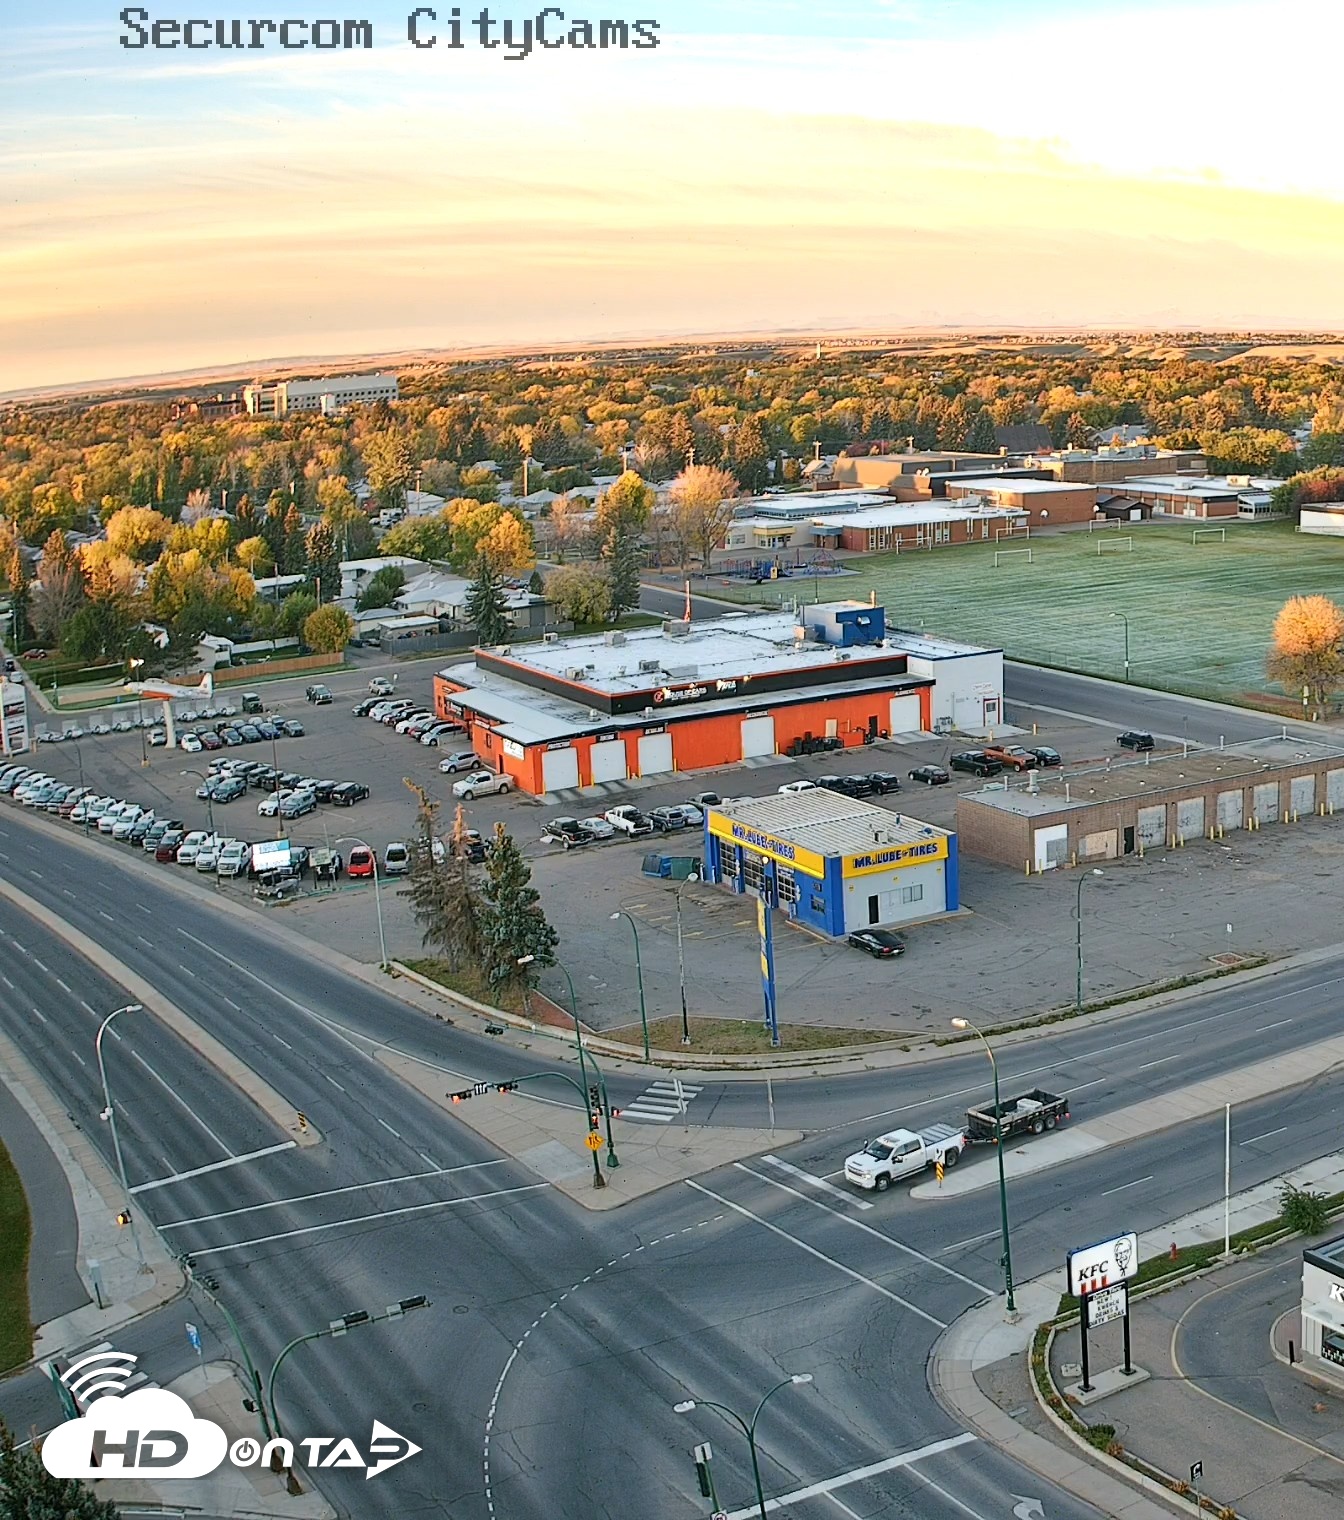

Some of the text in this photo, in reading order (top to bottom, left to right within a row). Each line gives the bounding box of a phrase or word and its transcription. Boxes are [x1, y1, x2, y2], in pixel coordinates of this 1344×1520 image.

[876, 849, 902, 864] LUBE
[909, 842, 938, 857] TIRES
[1078, 1260, 1109, 1281] KFC
